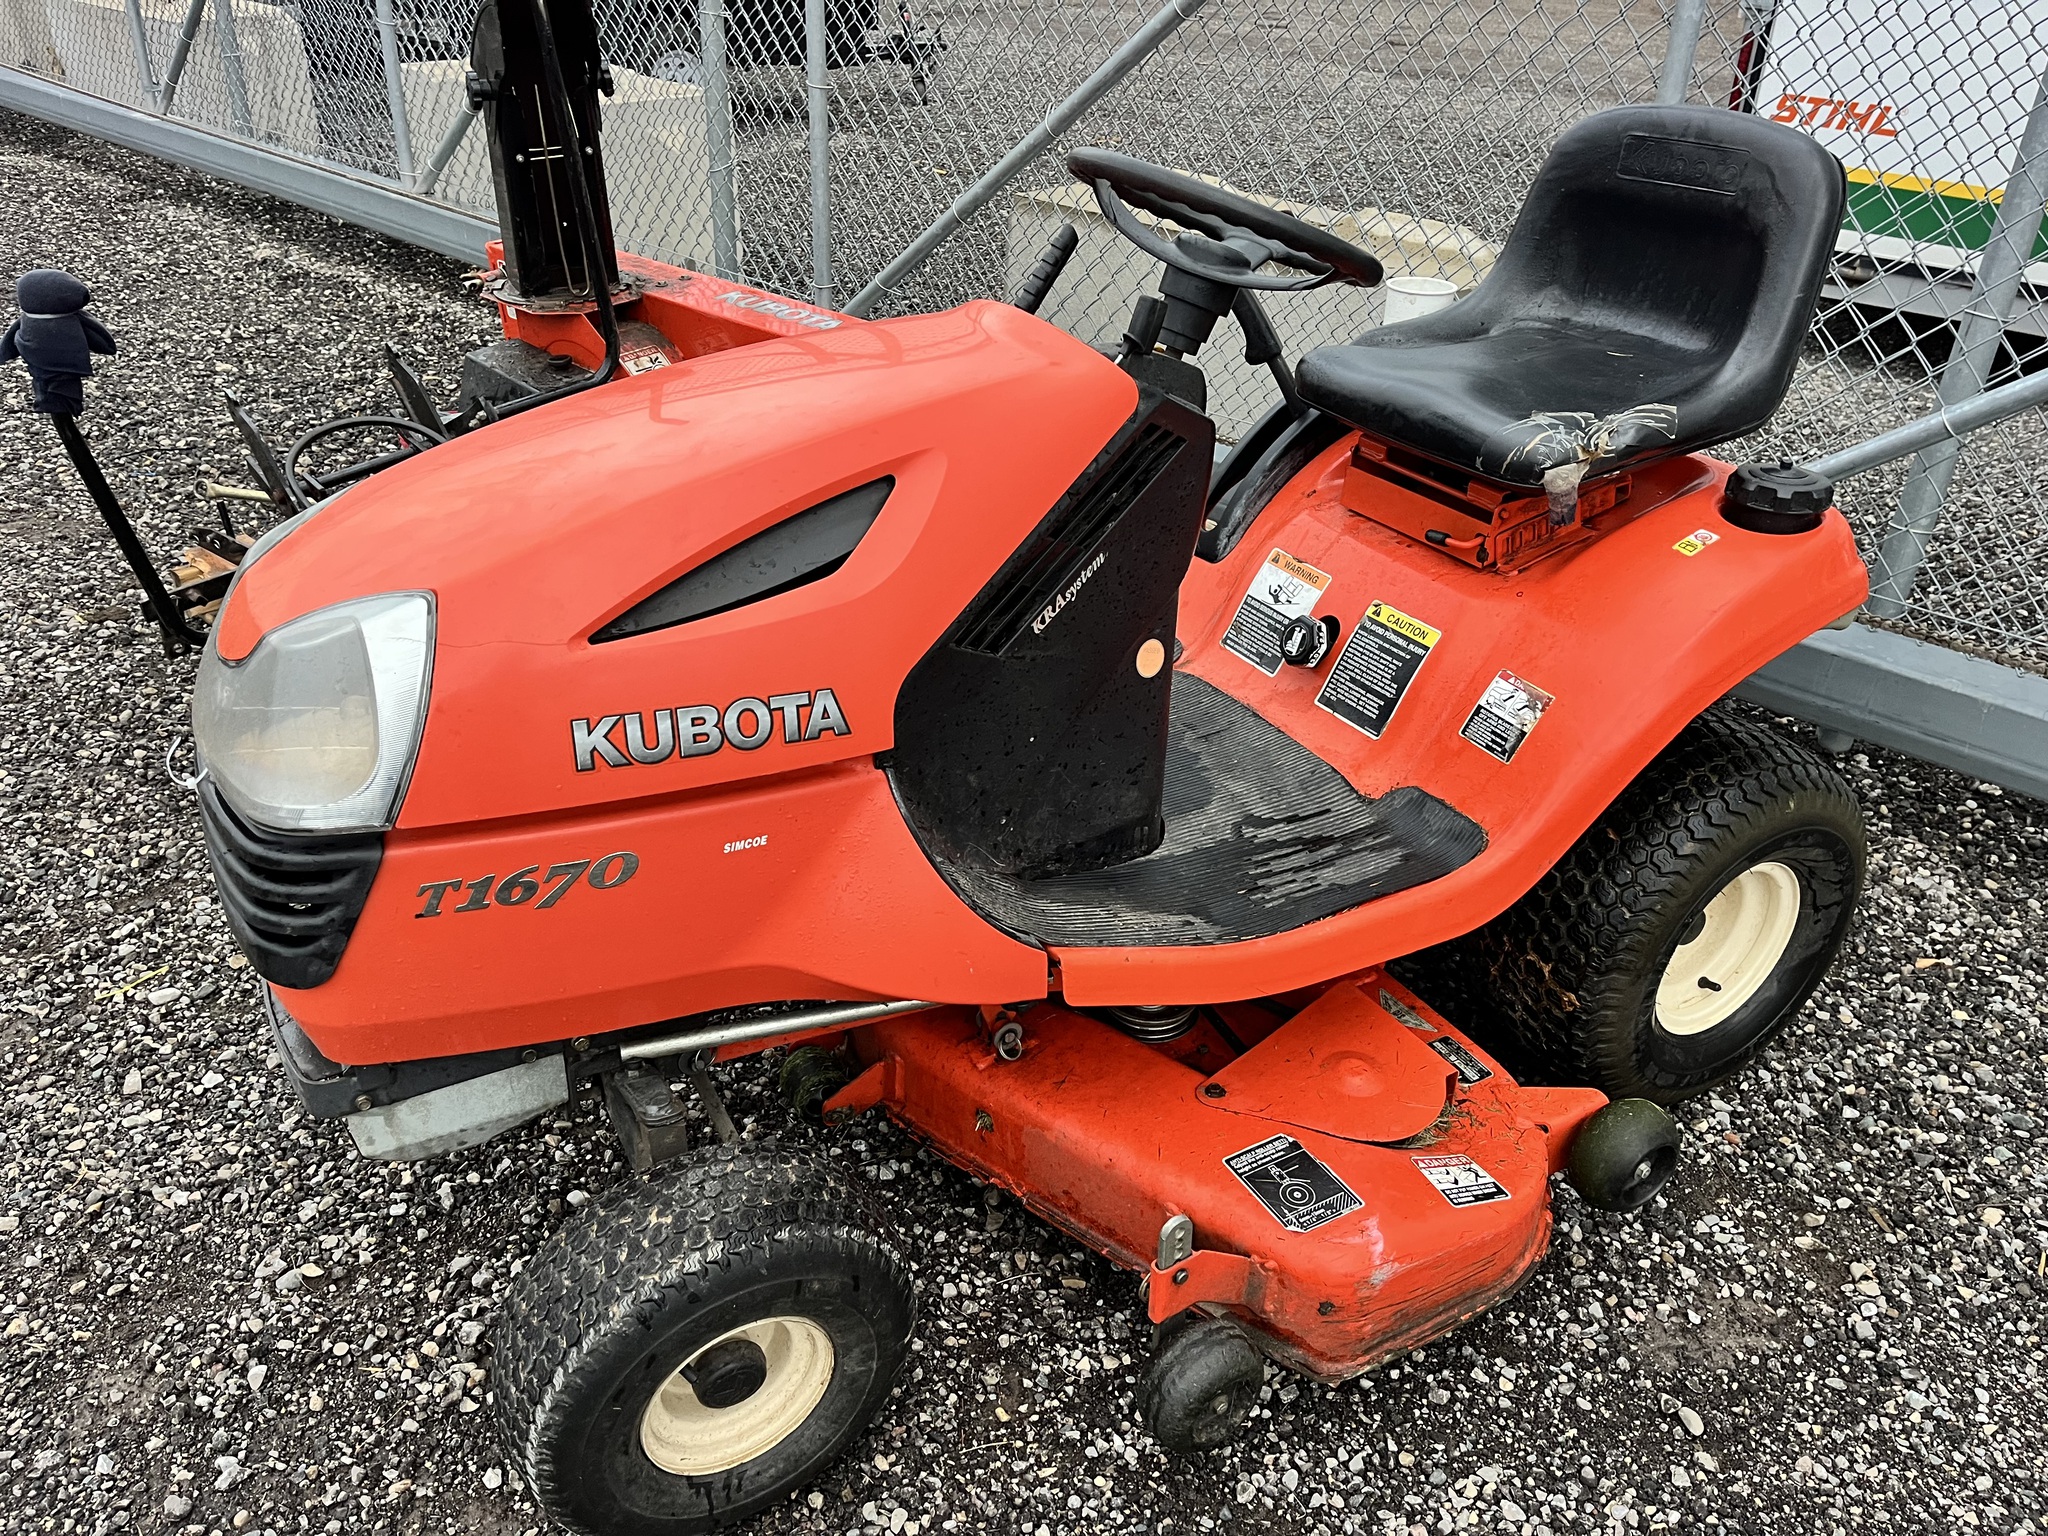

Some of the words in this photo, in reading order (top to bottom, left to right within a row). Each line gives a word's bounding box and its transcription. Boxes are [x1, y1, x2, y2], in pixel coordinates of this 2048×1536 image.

[1769, 94, 1897, 137] STIHL
[714, 290, 844, 331] KUBOTA
[1284, 560, 1319, 585] WARNING
[1386, 613, 1429, 641] CAUTION
[570, 688, 851, 773] KUBOTA
[723, 834, 769, 854] SIMCOE
[414, 851, 640, 920] T1670
[1423, 1156, 1471, 1167] DANGER
